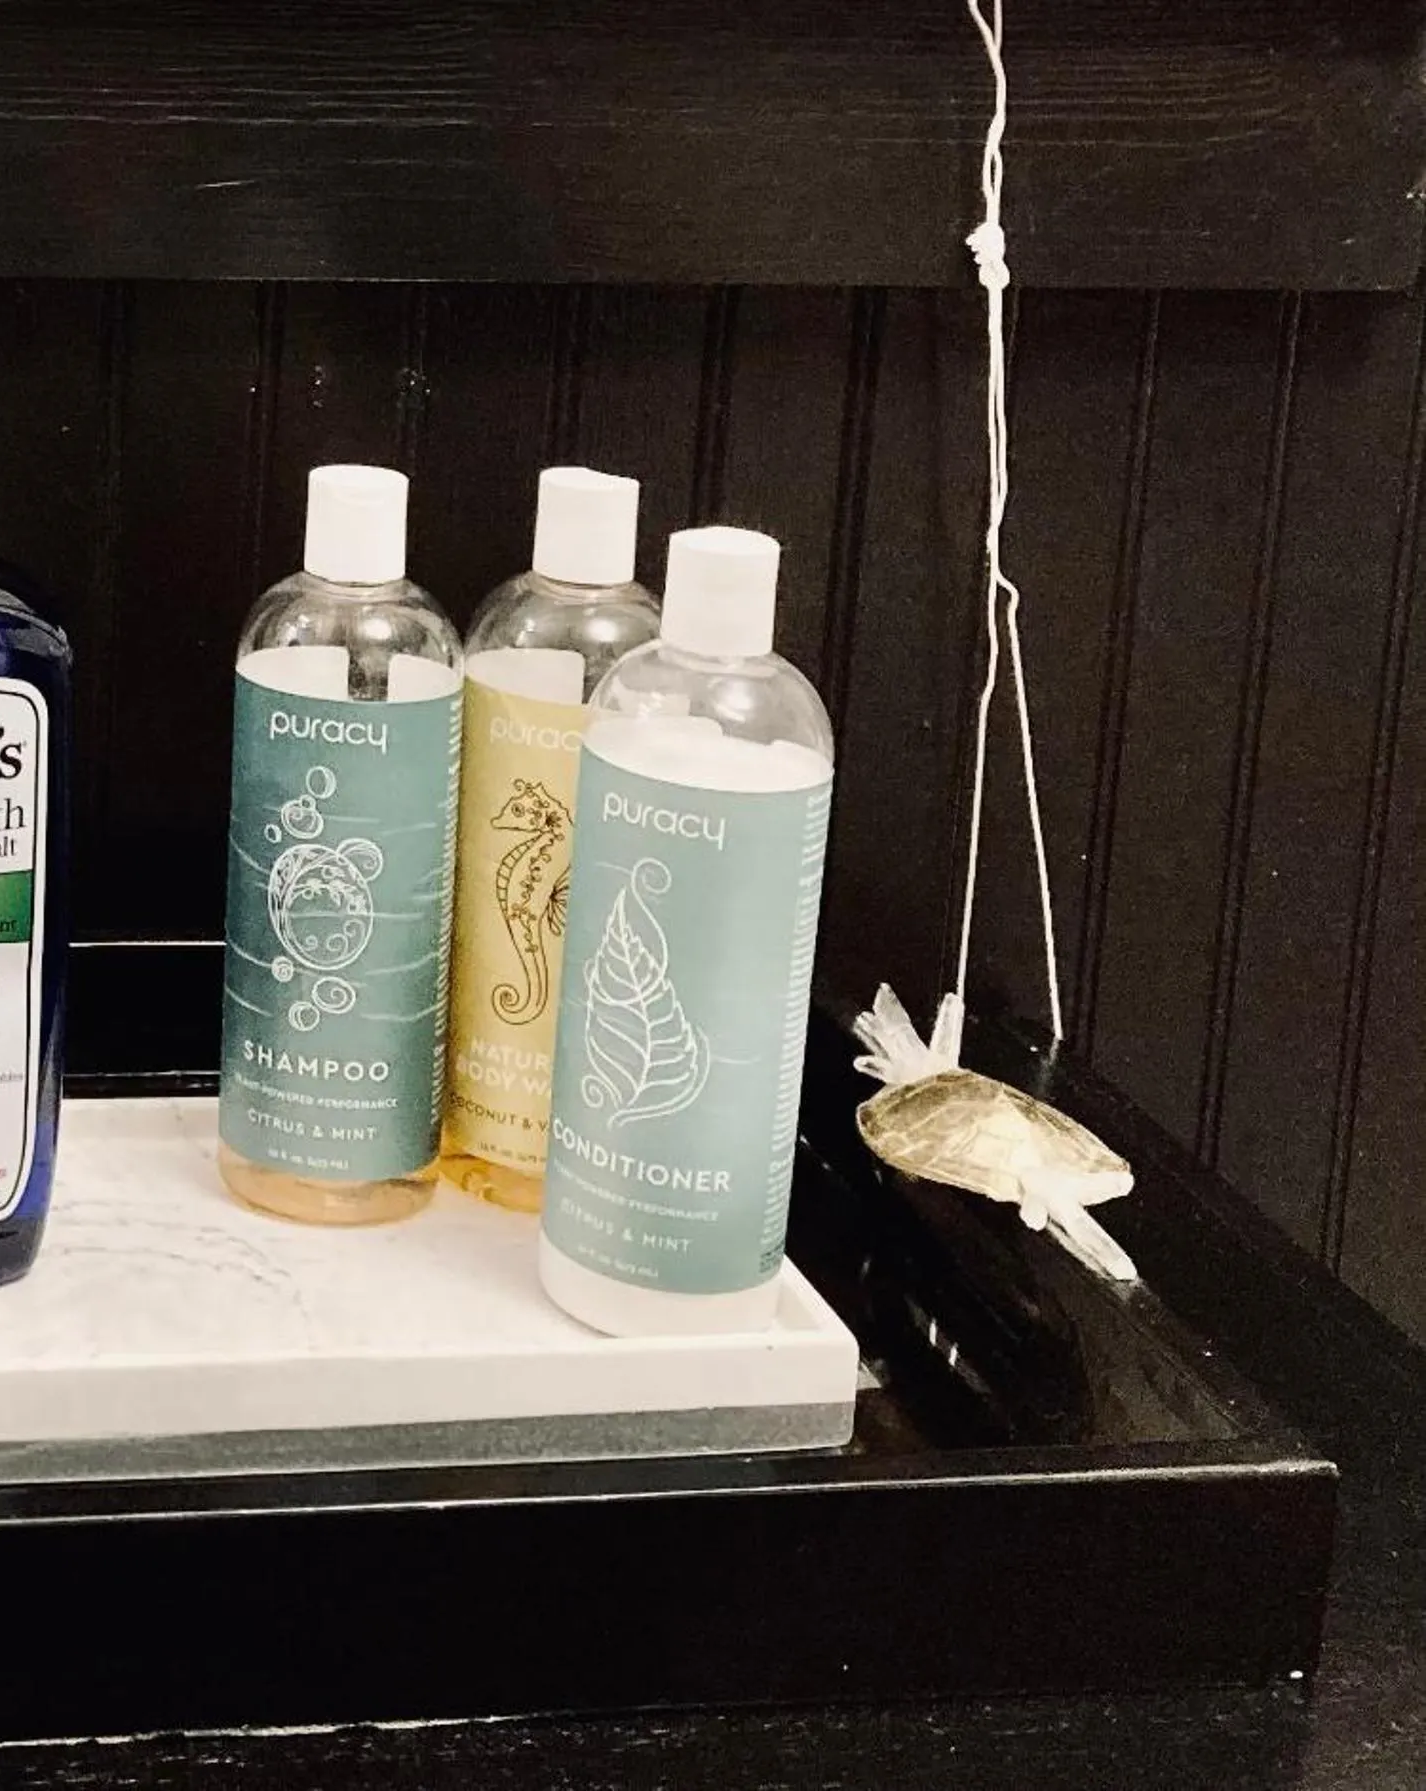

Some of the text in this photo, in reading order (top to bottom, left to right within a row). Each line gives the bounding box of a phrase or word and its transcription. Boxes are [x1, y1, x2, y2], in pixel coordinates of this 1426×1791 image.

[269, 710, 389, 755] puracy
[489, 715, 583, 752] purac
[602, 791, 727, 851] puracy
[243, 1039, 390, 1083] SHAMPOO
[455, 1053, 517, 1094] BODY
[470, 1036, 551, 1074] NATUR
[247, 1107, 306, 1137] CITRUS
[331, 1125, 378, 1142] MINT
[552, 1117, 732, 1193] CONDITIONER
[559, 1196, 694, 1253] CITRUS & MINT
